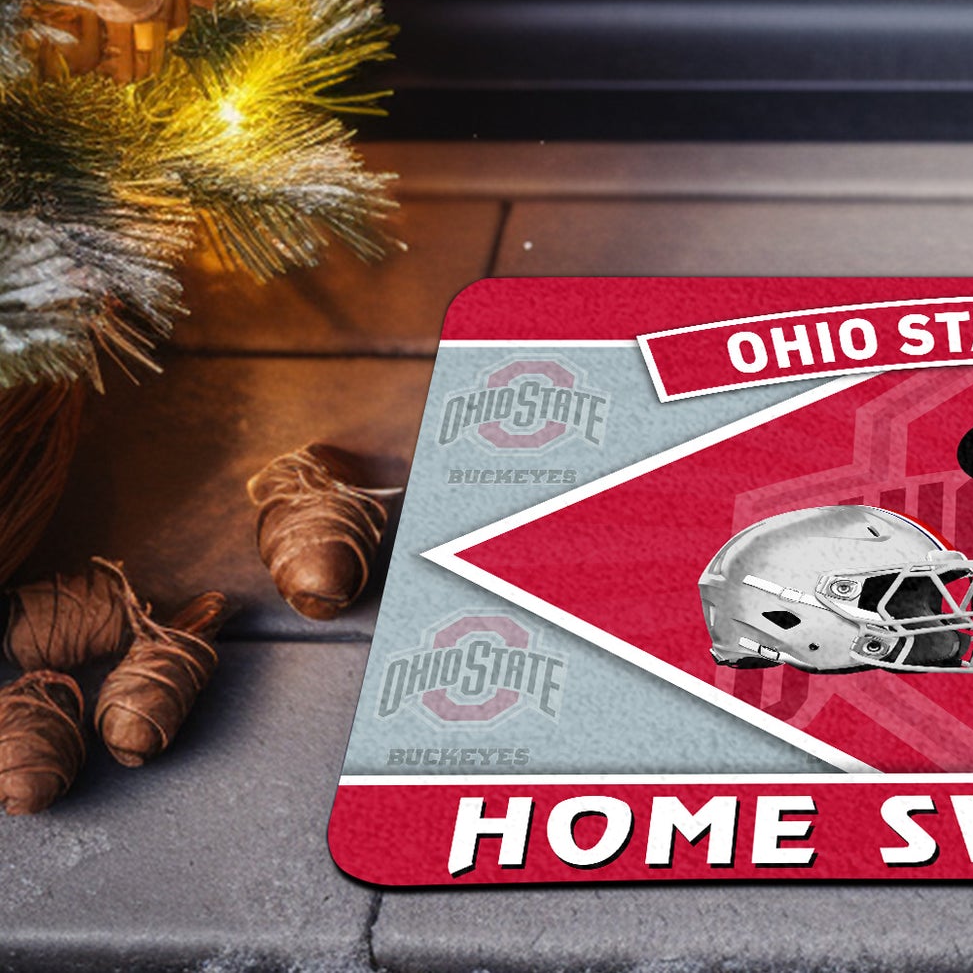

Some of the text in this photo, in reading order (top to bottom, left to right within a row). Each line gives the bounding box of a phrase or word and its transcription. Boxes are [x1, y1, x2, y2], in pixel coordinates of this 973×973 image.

[727, 317, 878, 374] OHIO
[447, 469, 578, 485] BUCKEYES
[386, 747, 531, 767] BUCKEYES
[447, 794, 818, 876] HOME
